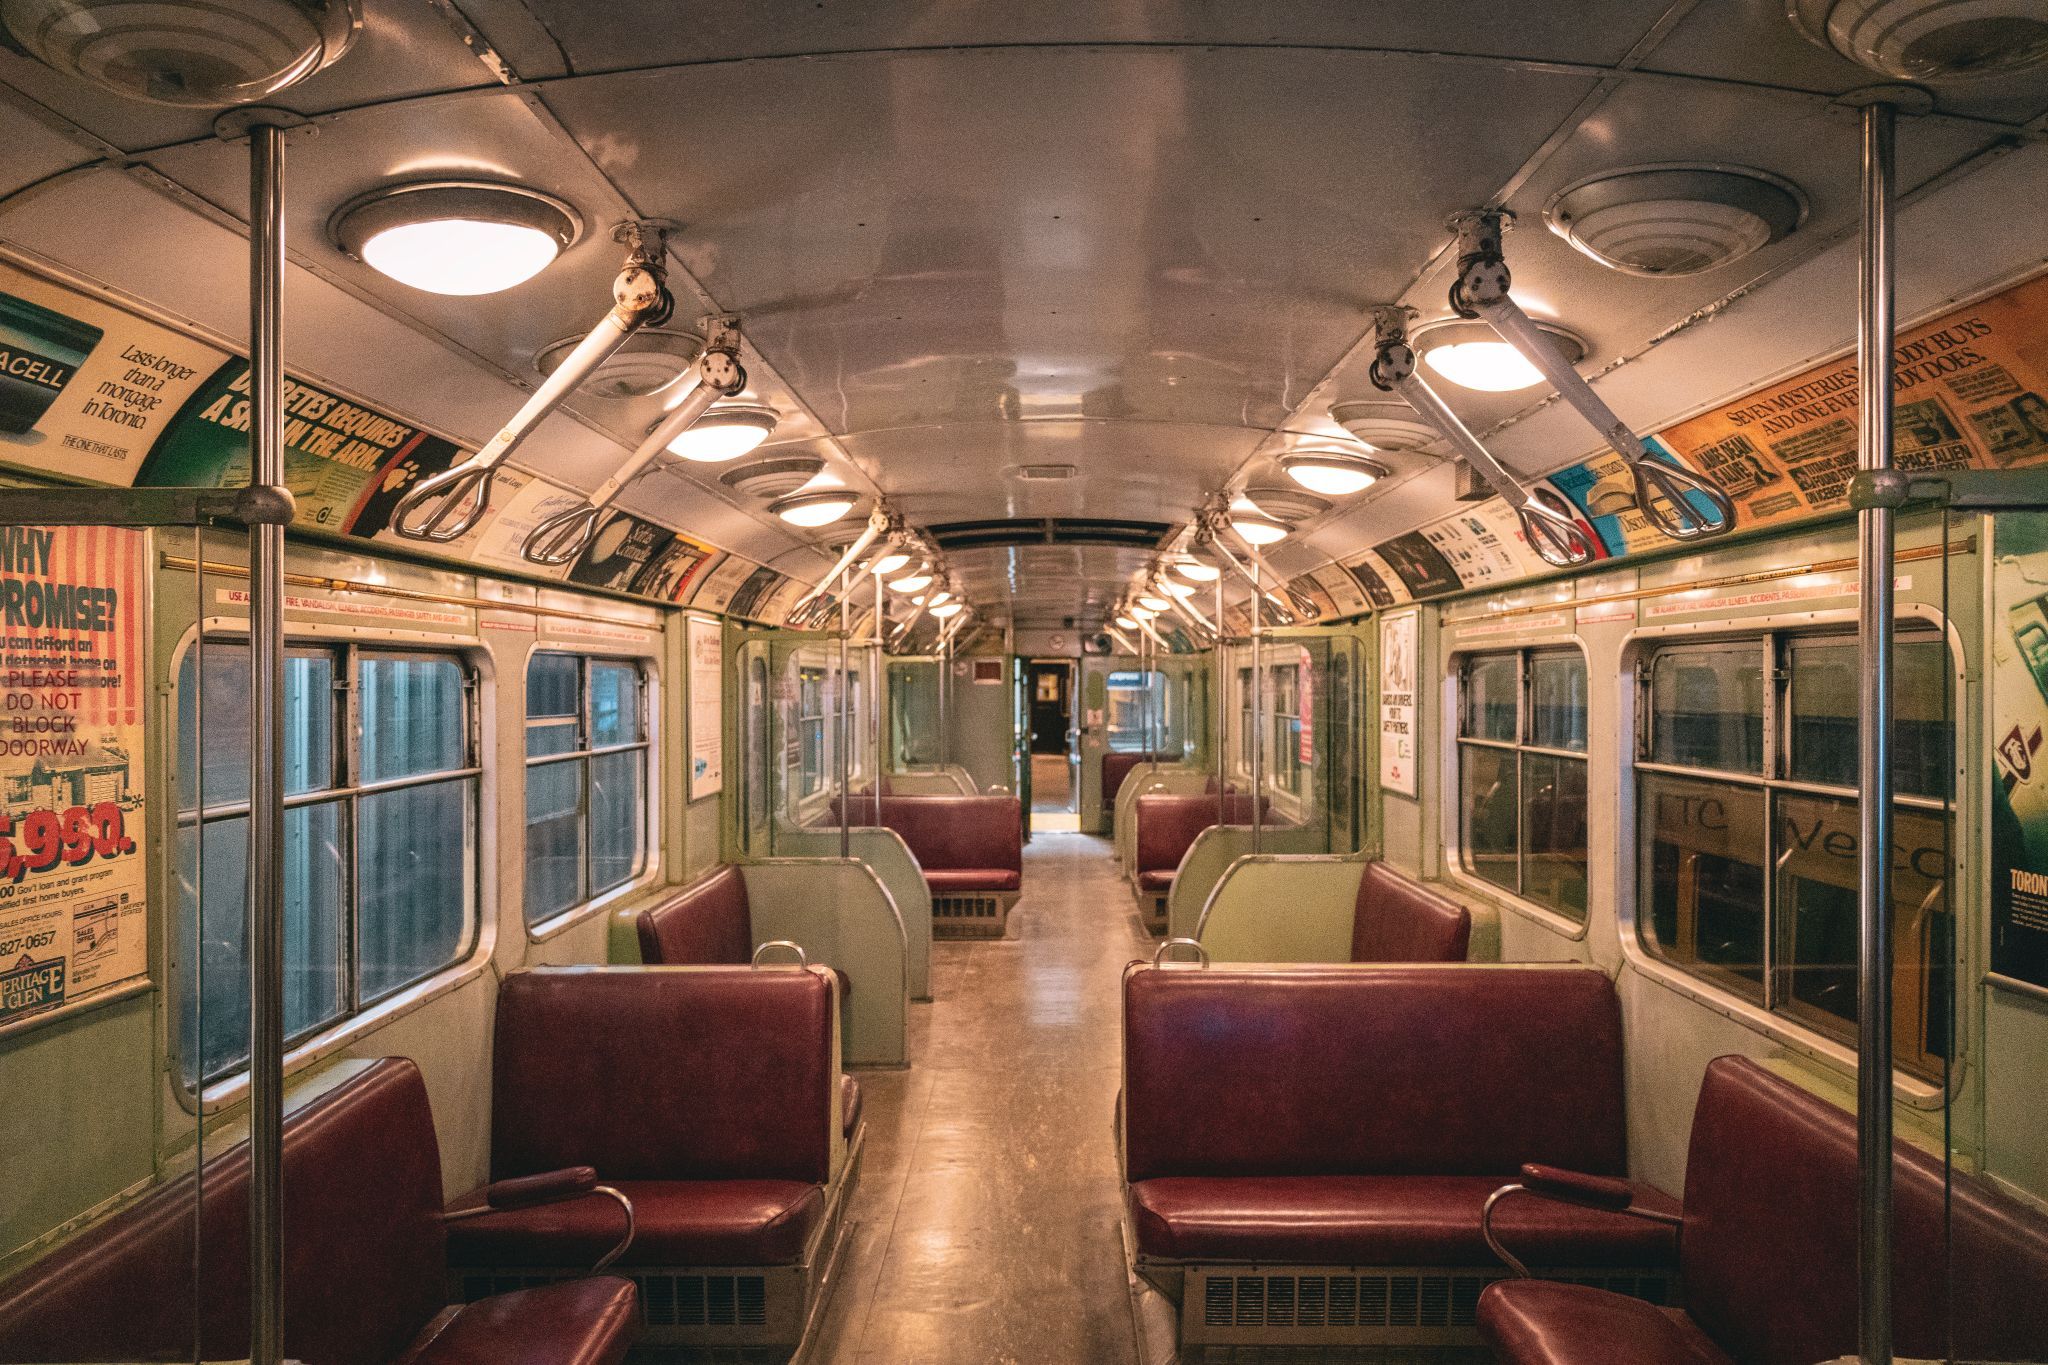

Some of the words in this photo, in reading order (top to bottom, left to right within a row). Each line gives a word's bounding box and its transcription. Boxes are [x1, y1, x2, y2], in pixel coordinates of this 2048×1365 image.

[120, 344, 157, 367] Lasts
[151, 355, 198, 381] longer
[1727, 401, 1776, 427] SEVEN
[1772, 369, 1858, 412] MYSTERIES
[1931, 317, 1992, 351] BUYS
[123, 367, 156, 389] than
[152, 379, 165, 392] a
[1760, 413, 1796, 436] AND
[1791, 398, 1830, 424] ONE
[1921, 346, 1987, 380] DOES.
[96, 381, 162, 412] mortgage
[82, 398, 100, 416] in
[98, 402, 147, 429] Toronto.
[320, 402, 412, 450] REQUIRES
[198, 394, 234, 423] A
[299, 424, 348, 458] THE
[331, 441, 384, 473] ARM.
[62, 435, 77, 448] THE
[76, 439, 92, 451] ONE
[92, 442, 110, 455] THAT
[108, 447, 129, 460] LASTS
[1718, 435, 1753, 461] DEAN
[1894, 449, 1934, 469] SPACE
[1932, 444, 1973, 464] ALIEN
[0, 578, 118, 633] ROMISE?
[228, 591, 243, 602] USE
[8, 637, 33, 650] can
[34, 635, 76, 652] afford
[78, 640, 93, 653] an
[103, 659, 117, 671] on
[8, 670, 79, 688] PLEASE
[7, 693, 34, 711] DO
[41, 692, 82, 710] NOT
[13, 715, 76, 734] BLOCK
[0, 738, 89, 757] DOORWAY
[39, 881, 55, 891] loan
[56, 878, 70, 888] and
[72, 874, 89, 886] grant
[89, 868, 114, 882] program
[2009, 868, 2048, 897] TORON
[39, 891, 60, 903] home
[61, 886, 86, 899] buyers.
[8, 986, 43, 1010] GLEN
